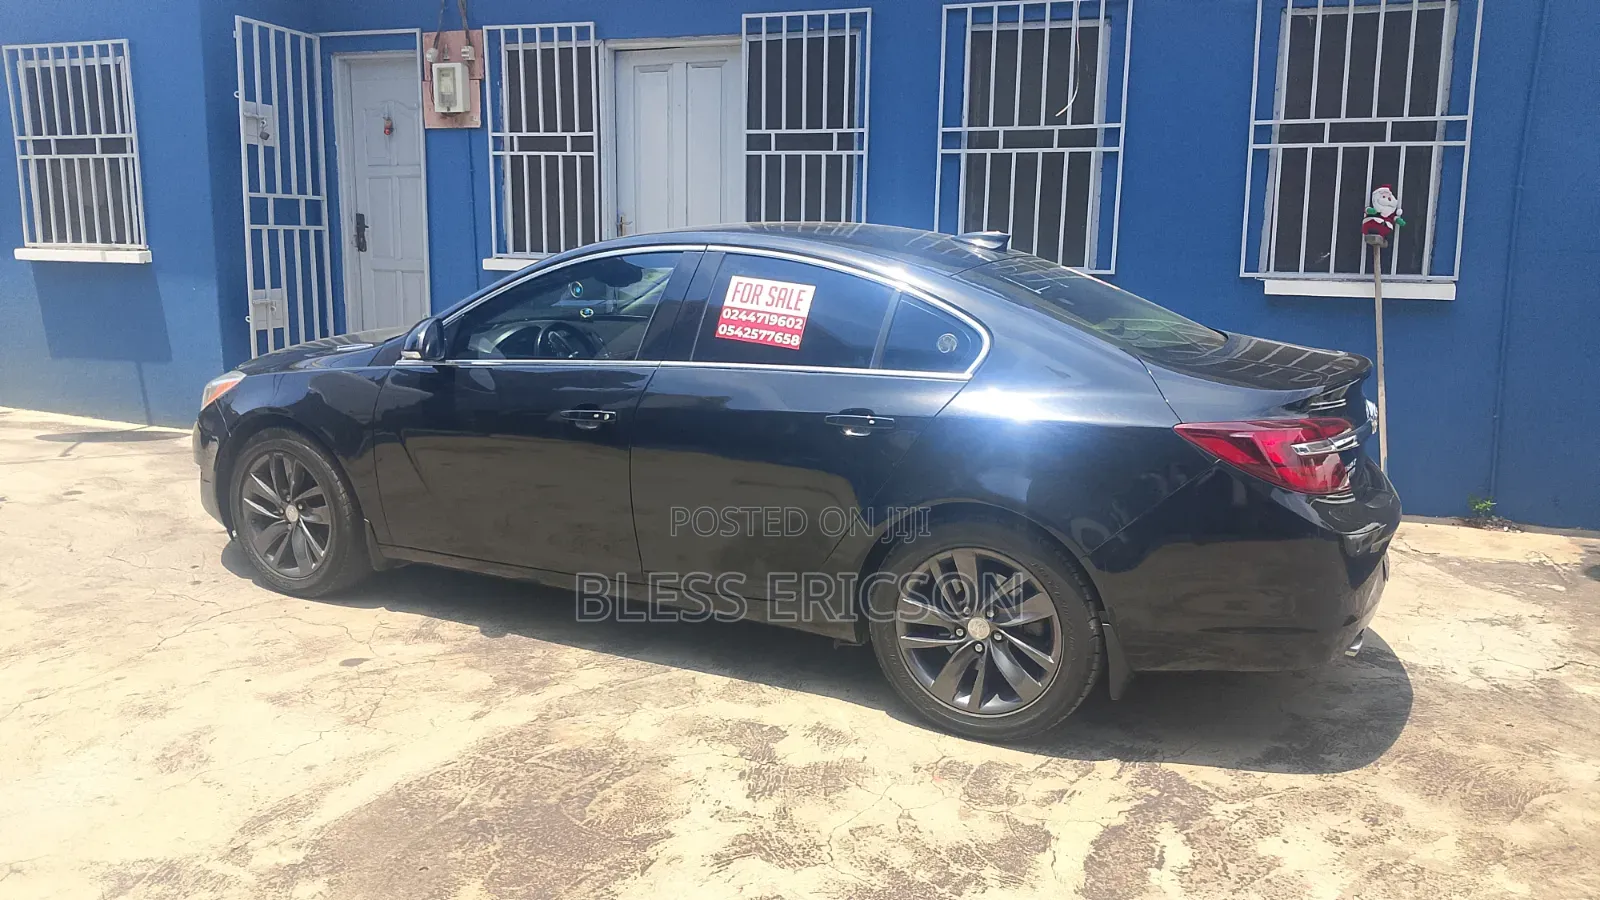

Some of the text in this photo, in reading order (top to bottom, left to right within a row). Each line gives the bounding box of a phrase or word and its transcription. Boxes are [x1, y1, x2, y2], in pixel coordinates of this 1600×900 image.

[731, 281, 807, 311] FOR SALE
[722, 308, 804, 329] 0244719602
[718, 324, 801, 346] 0542577658
